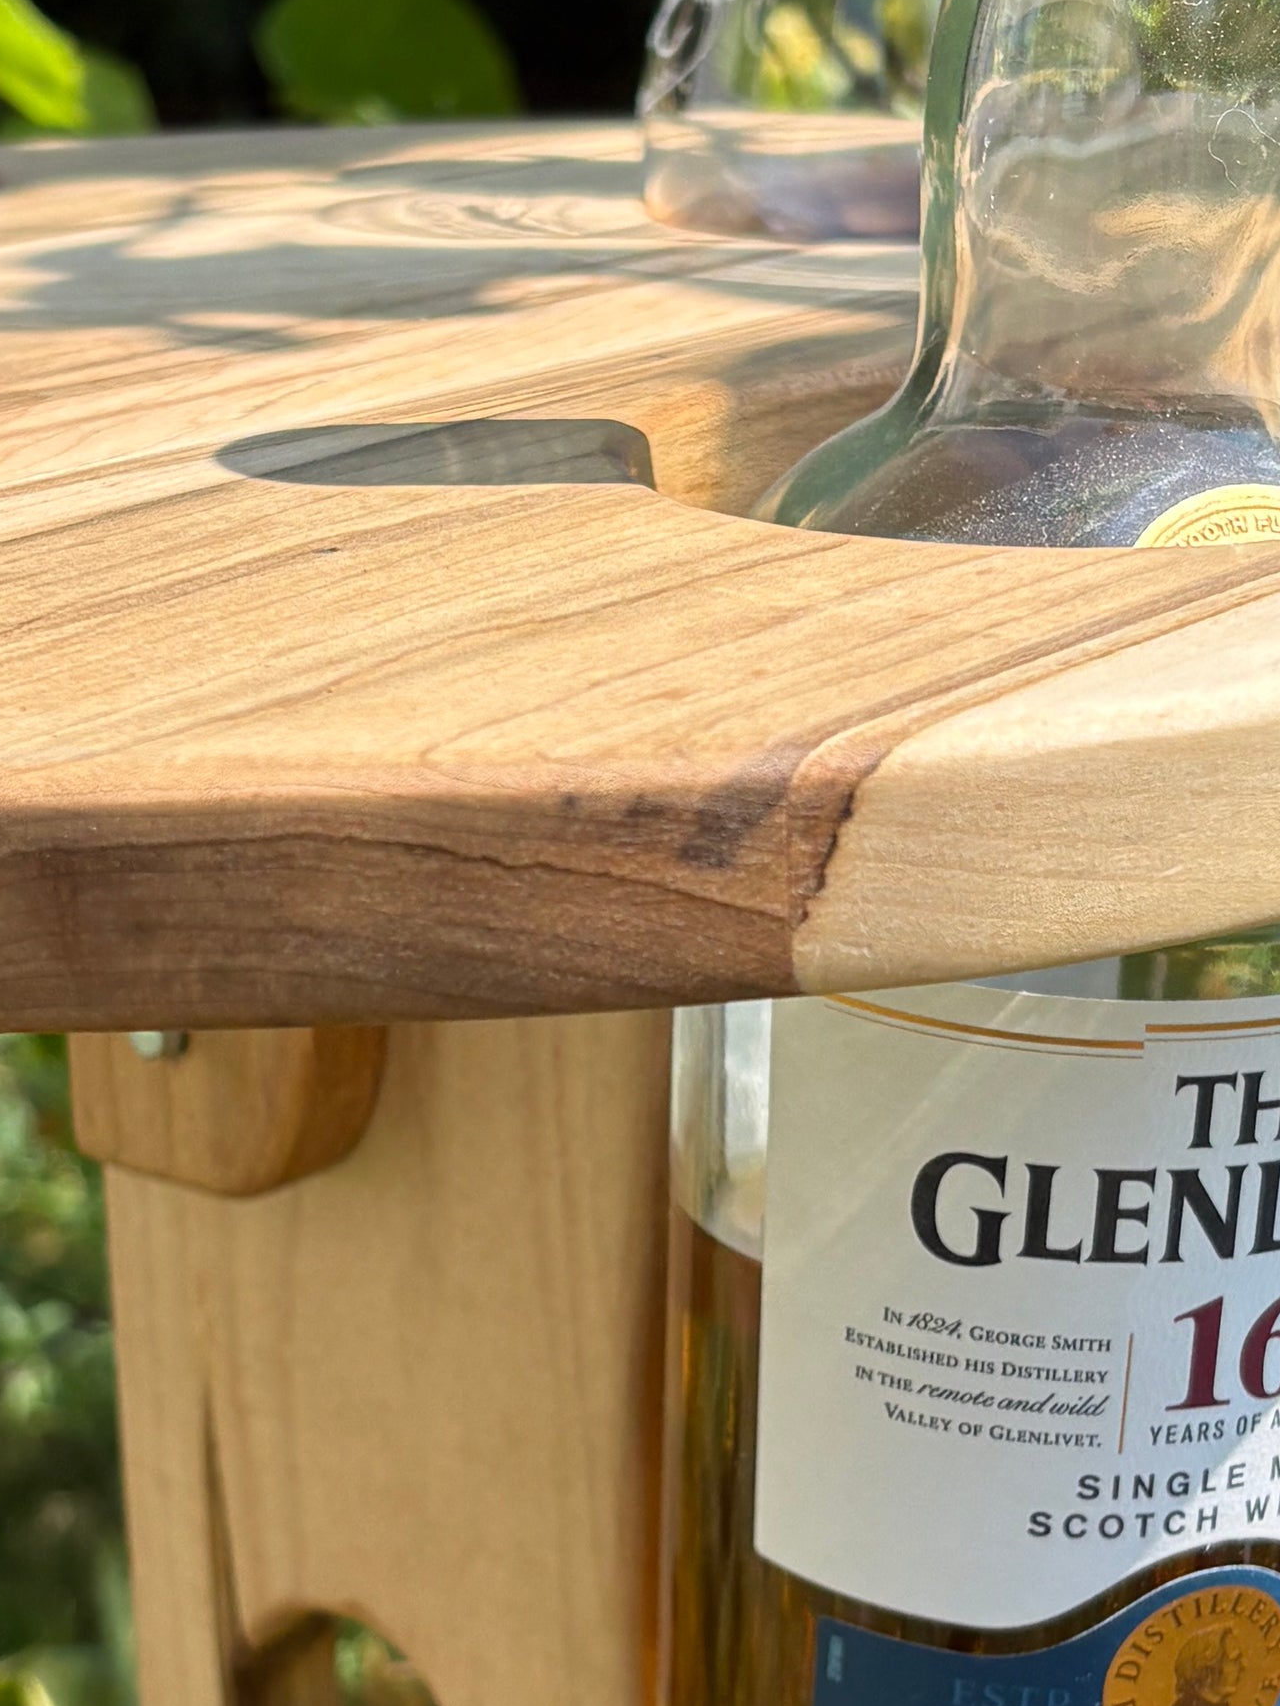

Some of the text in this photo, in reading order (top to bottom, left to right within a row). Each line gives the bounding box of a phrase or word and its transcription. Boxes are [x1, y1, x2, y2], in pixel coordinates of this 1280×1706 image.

[844, 1326, 1109, 1384] ESTABLISHED HIS DISTILLERY
[969, 1325, 1046, 1350] GEORGE
[1051, 1334, 1112, 1353] SMITH
[854, 1364, 1111, 1417] IN THE remote and wild
[884, 1401, 953, 1432] VALLEY
[957, 1421, 984, 1437] OF
[1150, 1420, 1225, 1447] YEARS
[1236, 1412, 1263, 1438] OF
[1076, 1461, 1248, 1502] SINGLE
[1026, 1505, 1219, 1540] SCOTCH
